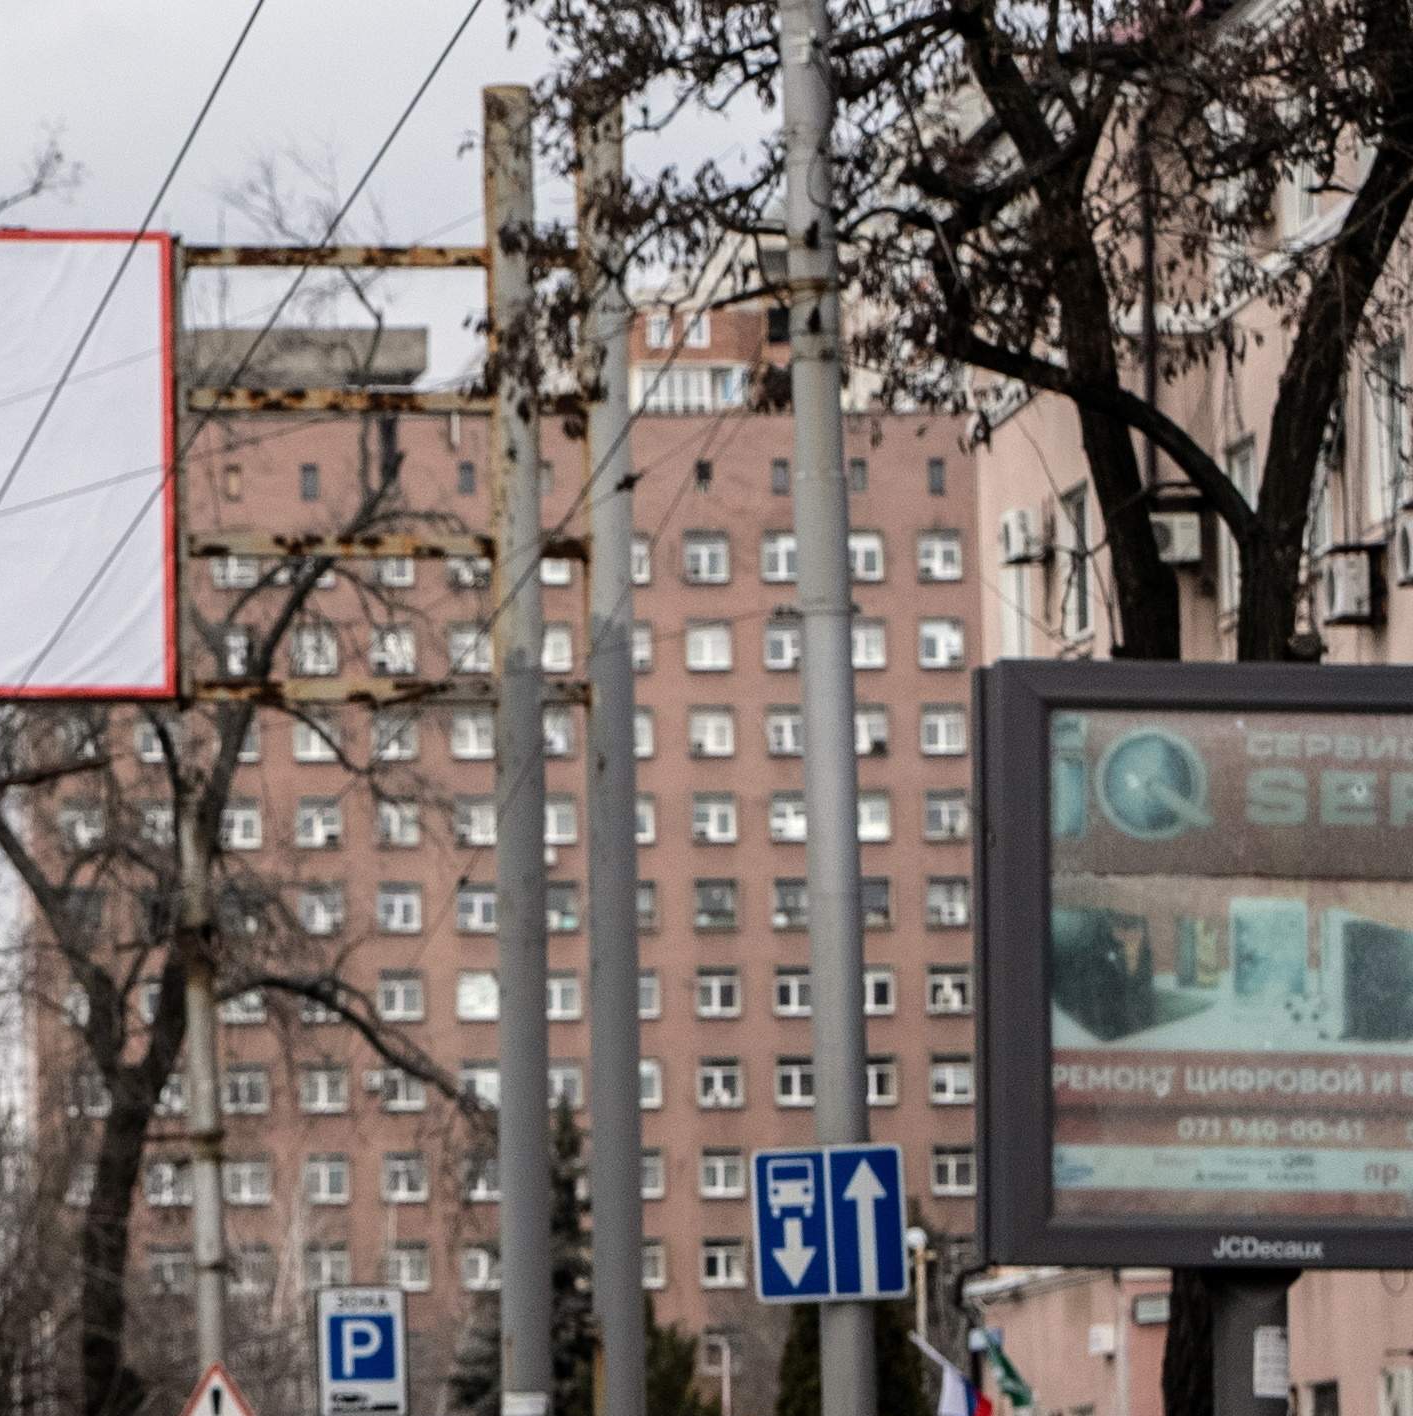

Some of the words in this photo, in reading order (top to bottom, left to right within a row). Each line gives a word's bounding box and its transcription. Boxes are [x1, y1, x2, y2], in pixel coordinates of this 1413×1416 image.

[1053, 1064, 1174, 1092] РЕМОНТ
[1184, 1064, 1366, 1096] ЦИФРОВОЙ
[1213, 1235, 1323, 1260] JCDecaux
